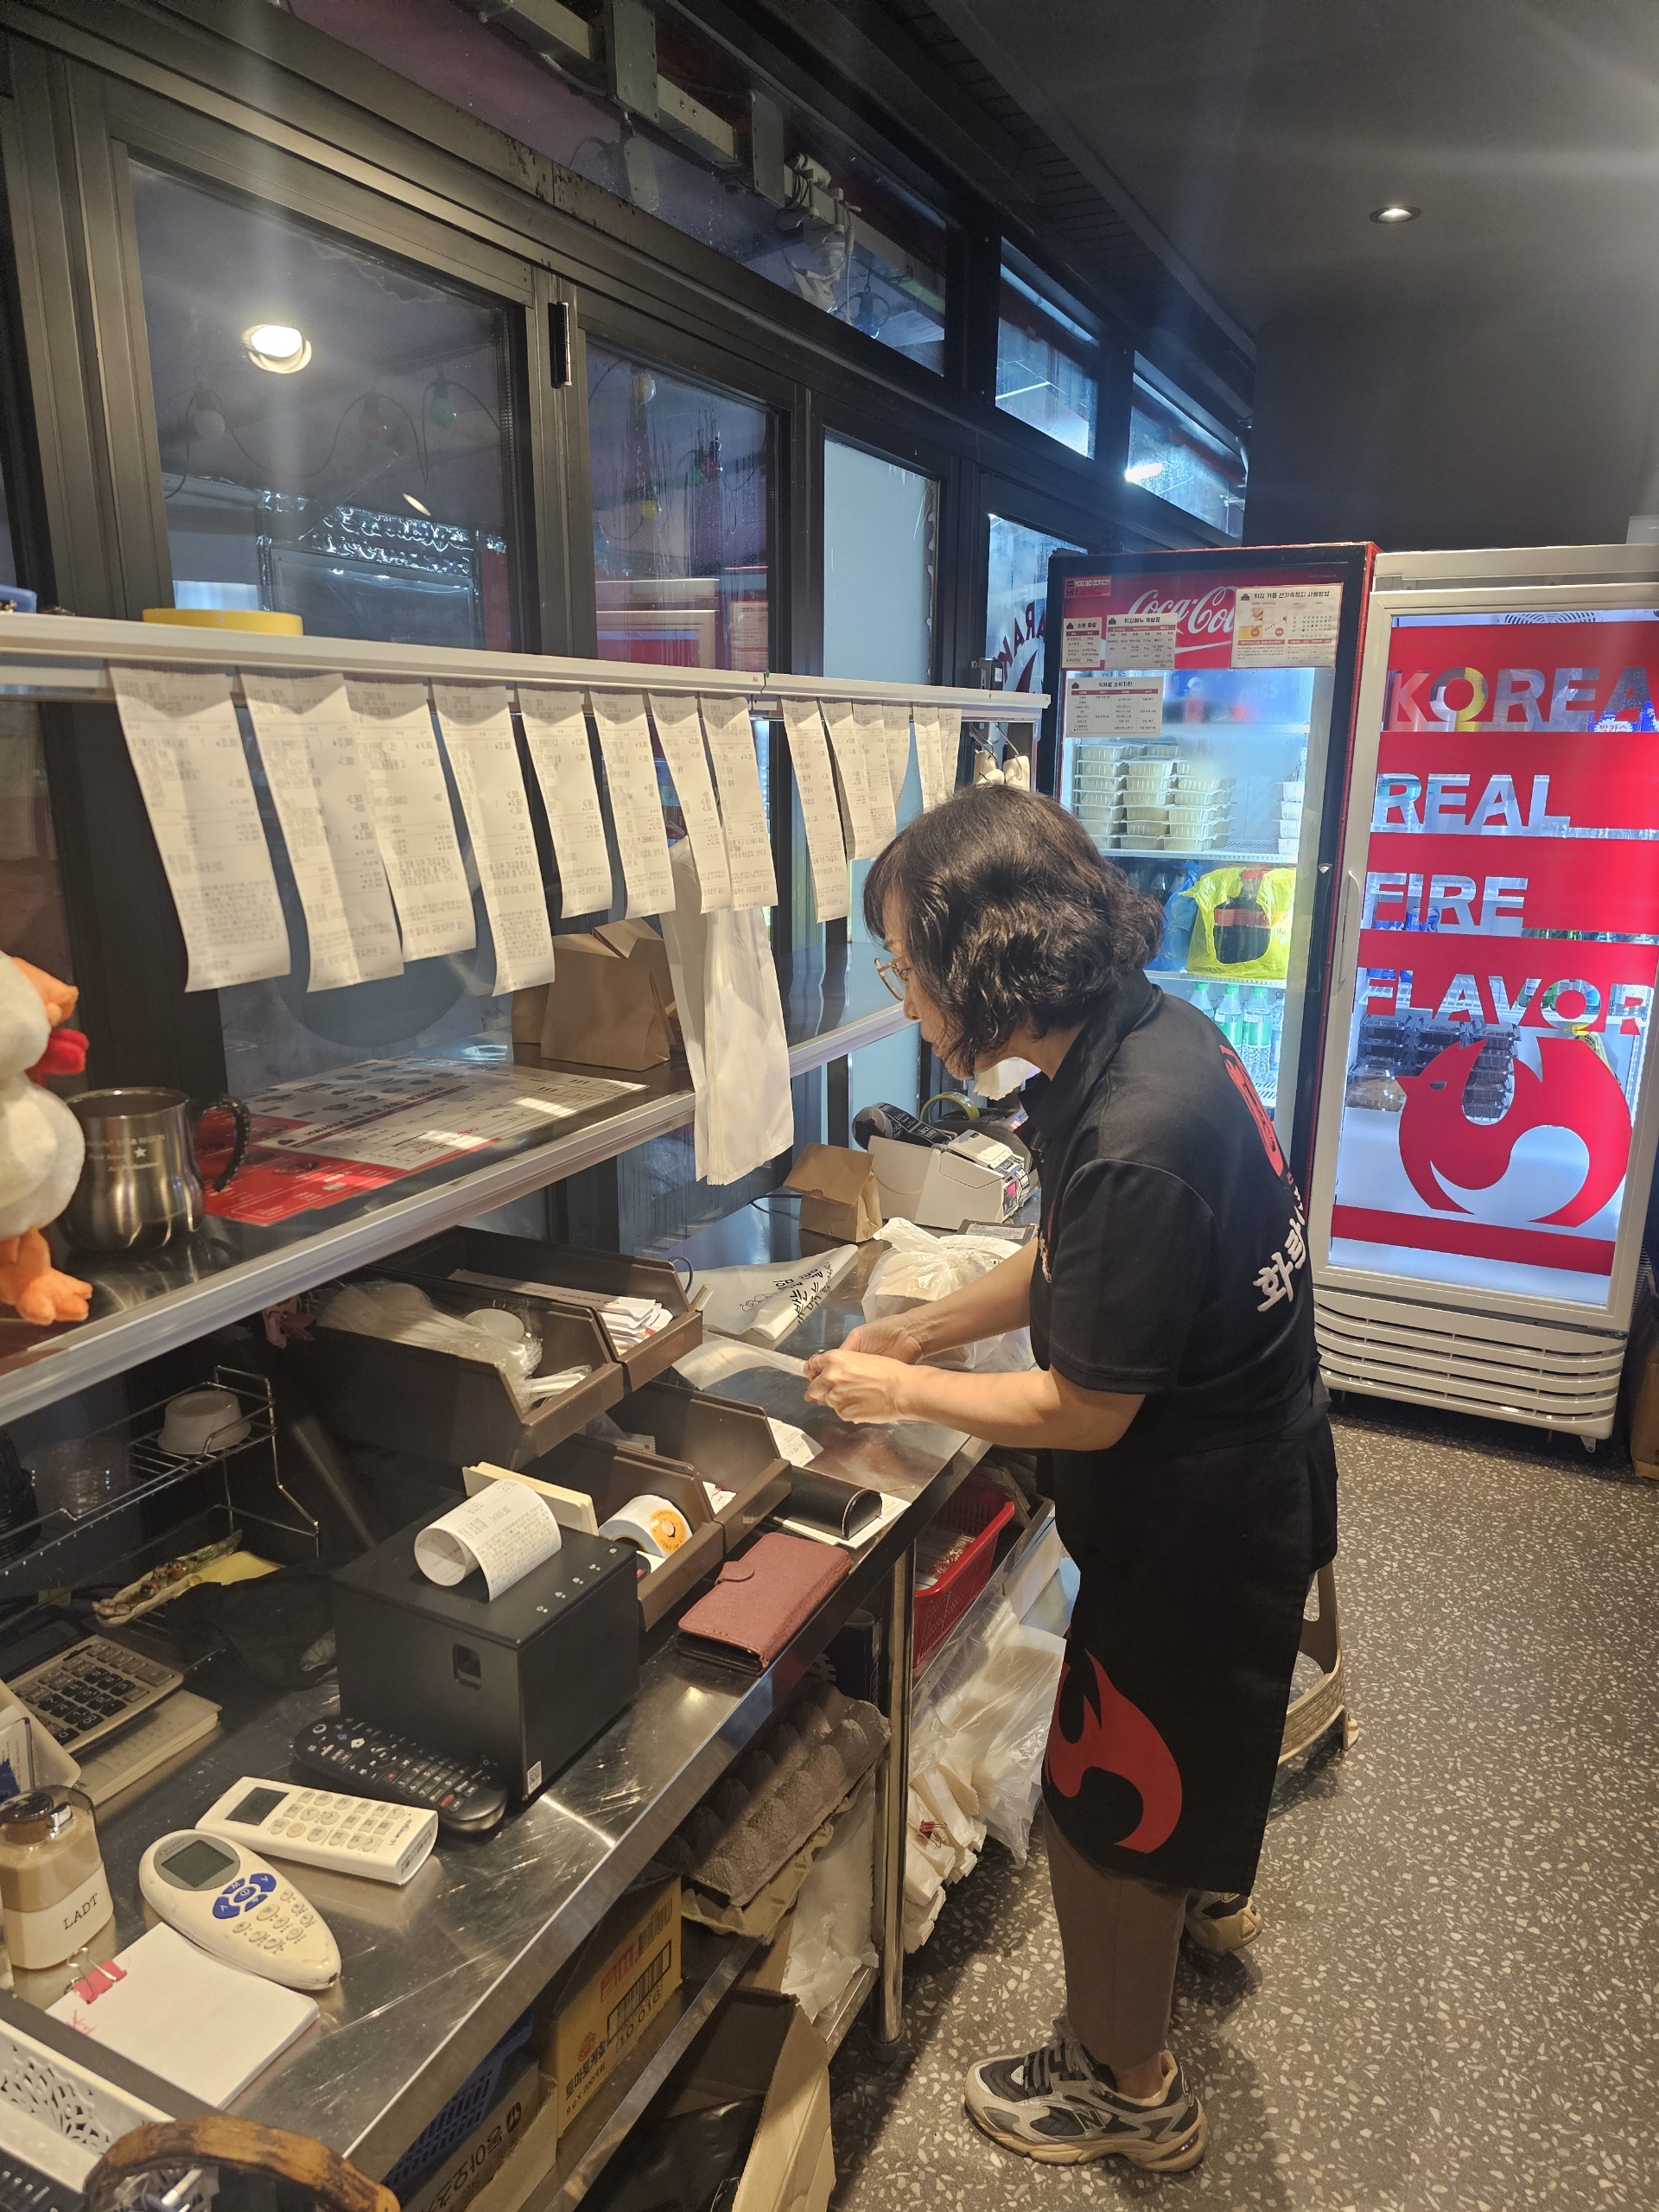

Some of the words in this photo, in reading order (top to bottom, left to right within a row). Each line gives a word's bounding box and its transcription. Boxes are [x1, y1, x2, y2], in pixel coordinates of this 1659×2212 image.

[1384, 666, 1659, 727] KOREA
[1372, 773, 1570, 829] REAL
[1362, 872, 1529, 931] FIRE
[1354, 967, 1655, 1036] FLAVOR
[62, 1892, 99, 1930] LADT
